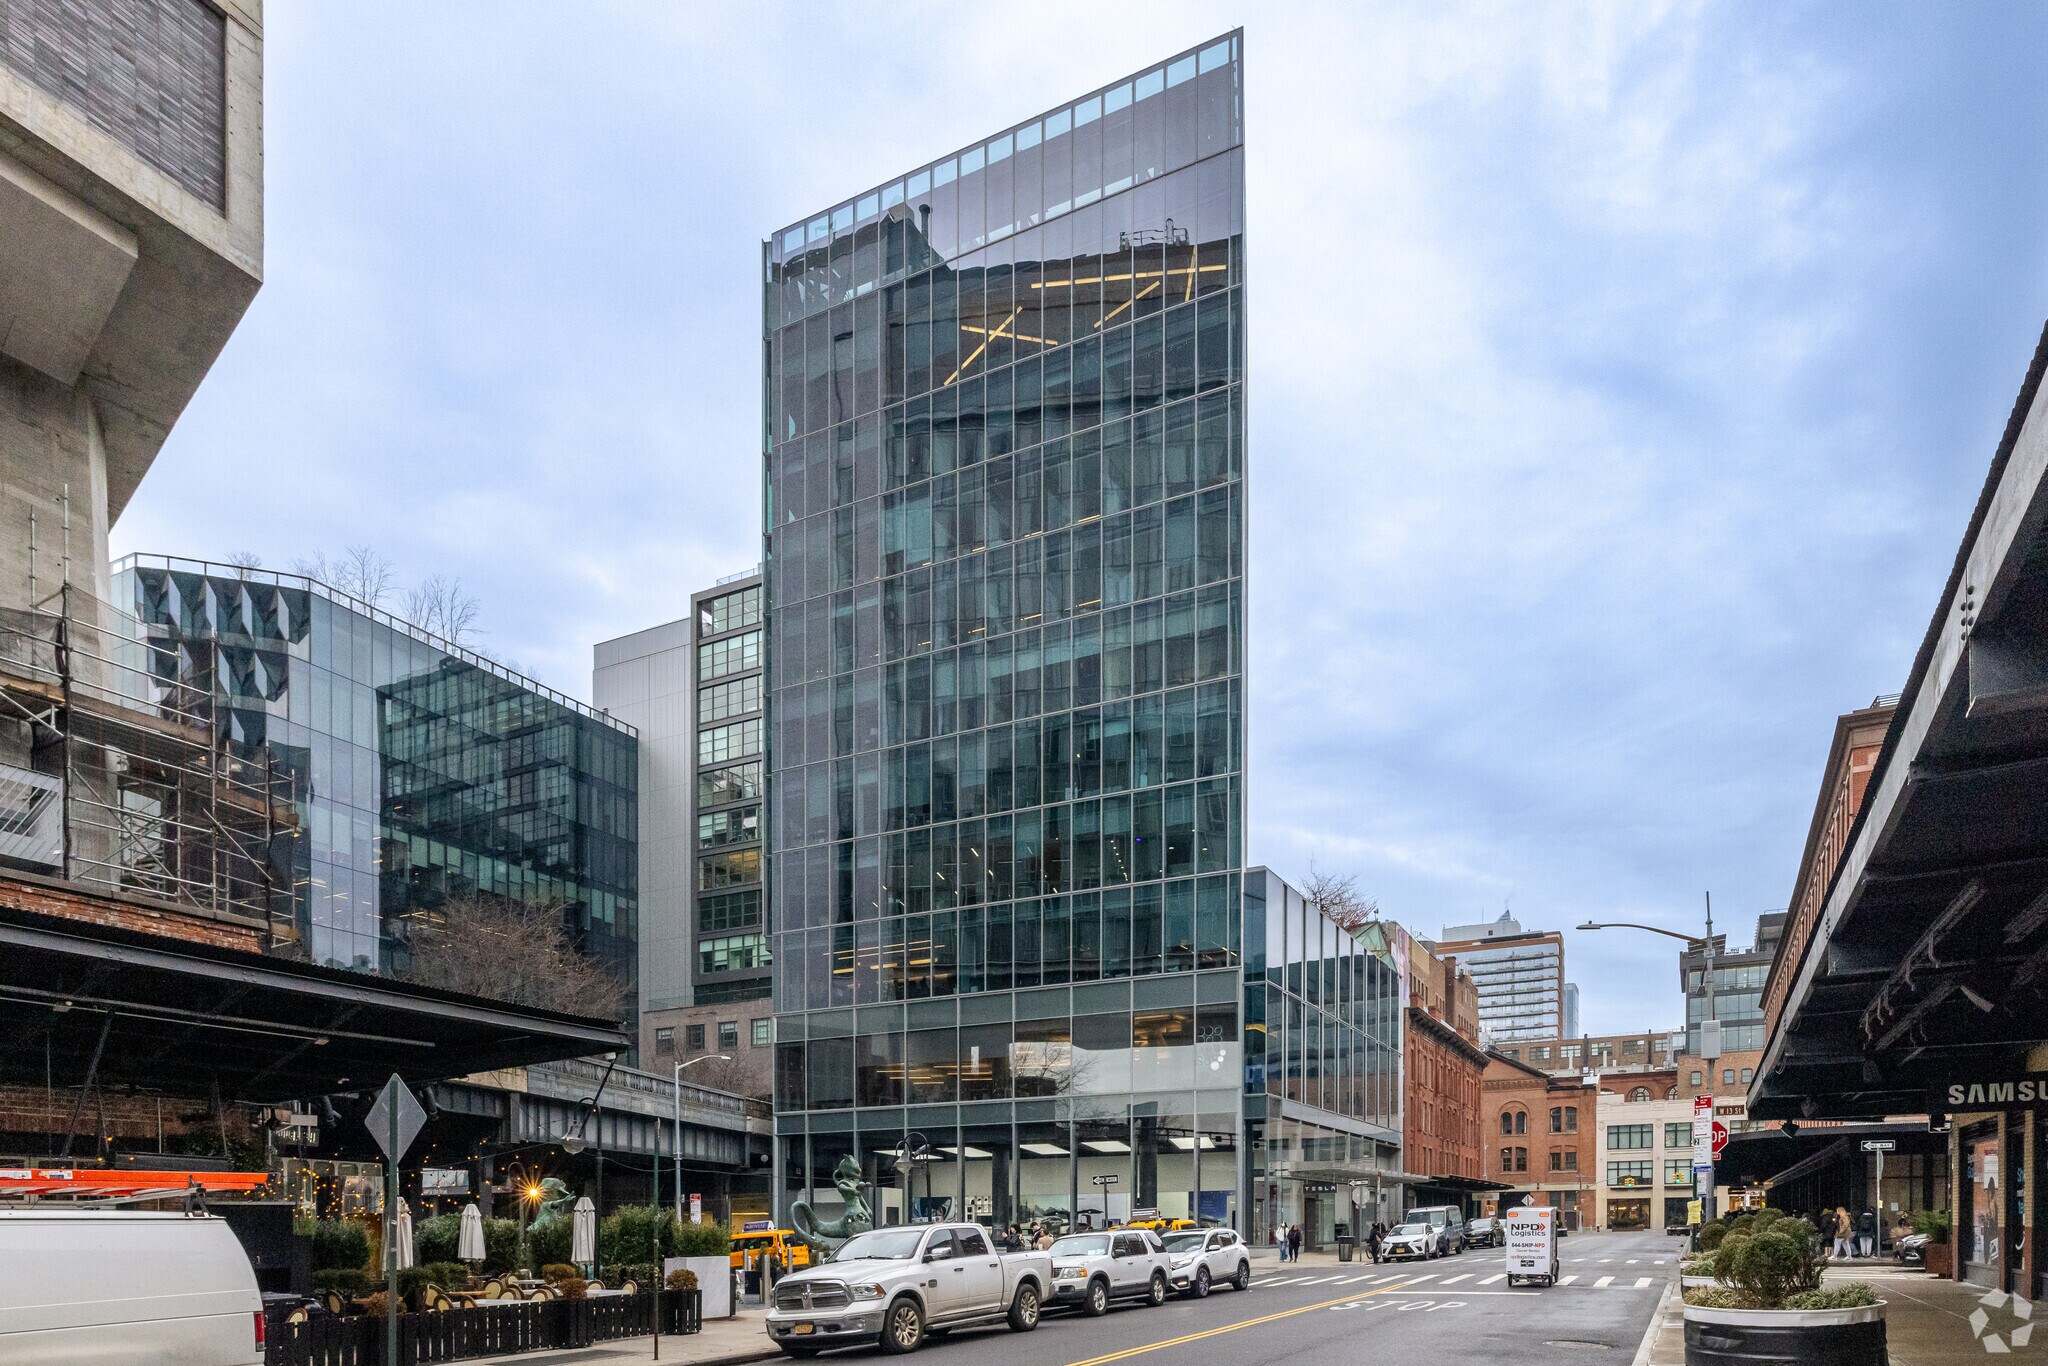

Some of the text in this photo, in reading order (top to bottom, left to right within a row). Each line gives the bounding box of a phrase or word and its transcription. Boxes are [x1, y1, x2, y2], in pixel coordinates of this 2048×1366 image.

[1734, 1107, 1741, 1115] St
[1511, 1223, 1539, 1231] NPD
[1329, 1300, 1468, 1312] STOP
